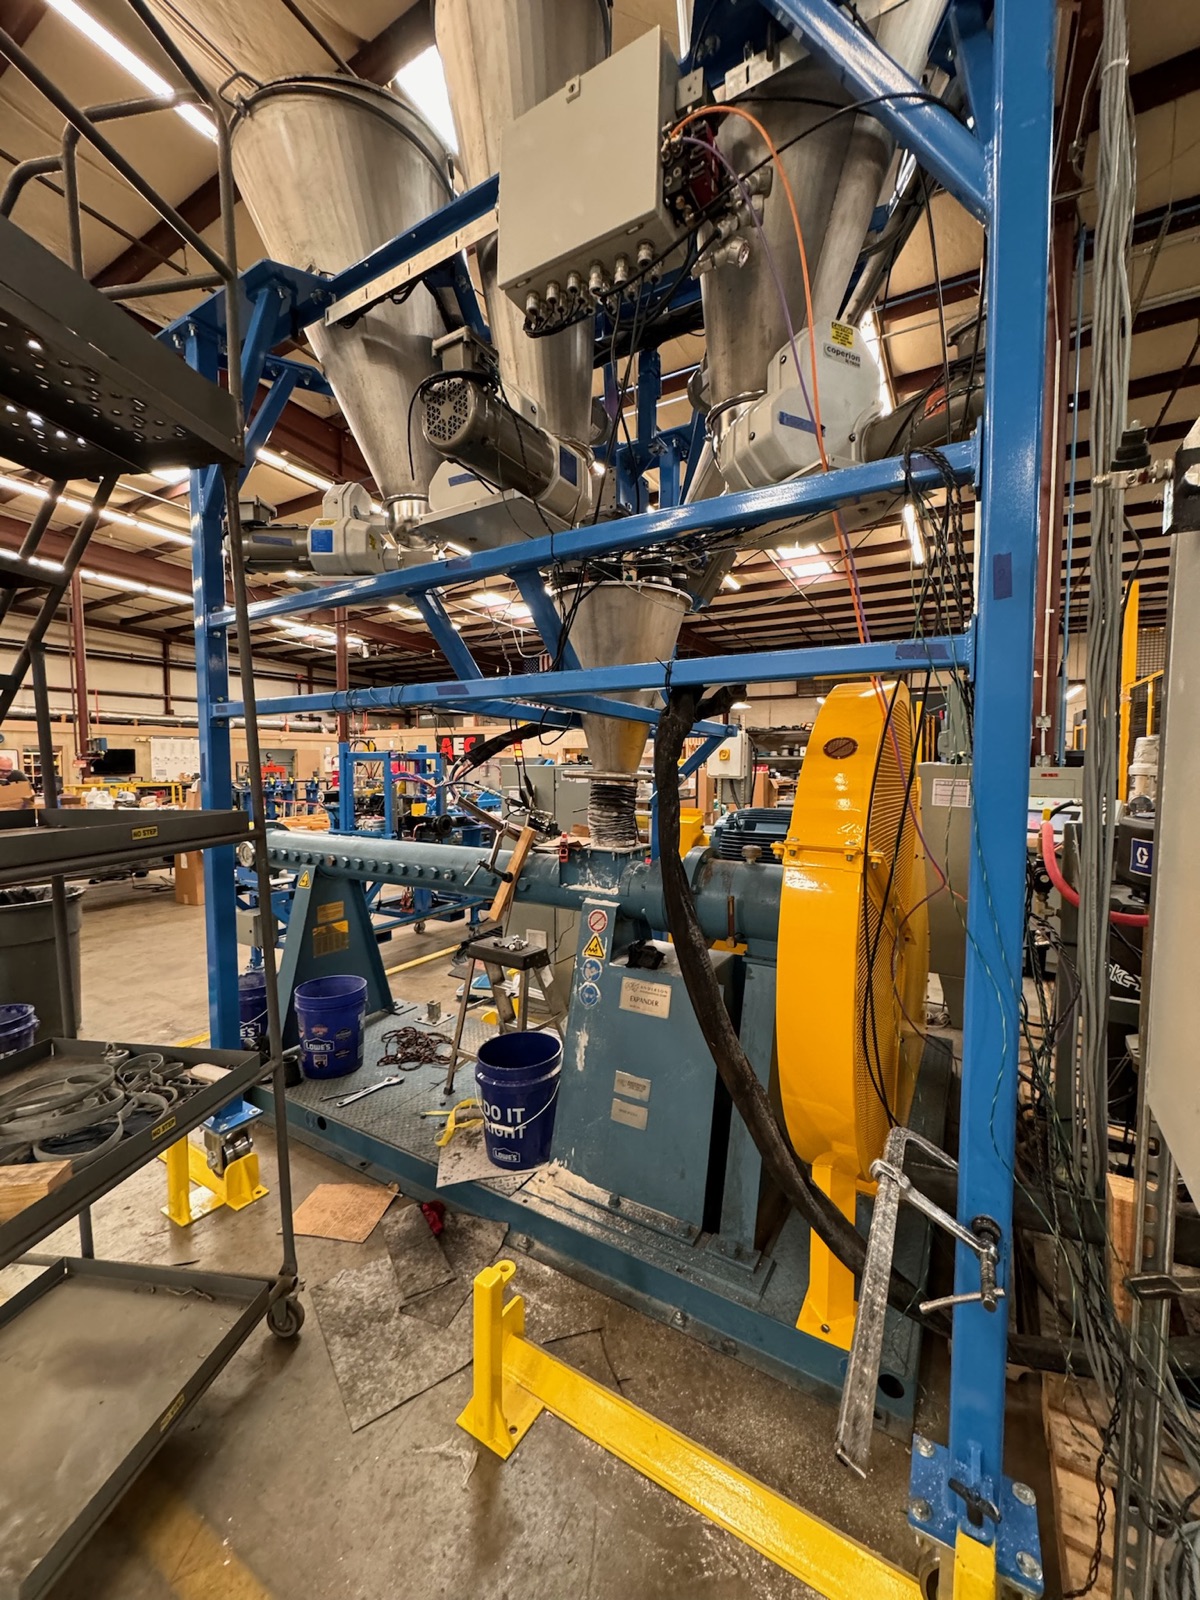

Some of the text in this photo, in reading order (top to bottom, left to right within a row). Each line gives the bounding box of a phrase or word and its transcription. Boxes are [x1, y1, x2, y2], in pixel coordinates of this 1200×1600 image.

[826, 346, 860, 362] coperion
[440, 736, 476, 762] AEC
[629, 995, 659, 1007] EXPANDER
[305, 1042, 331, 1051] LOWE'S
[483, 1100, 525, 1123] DO IT
[494, 1149, 518, 1161] LOWE'S
